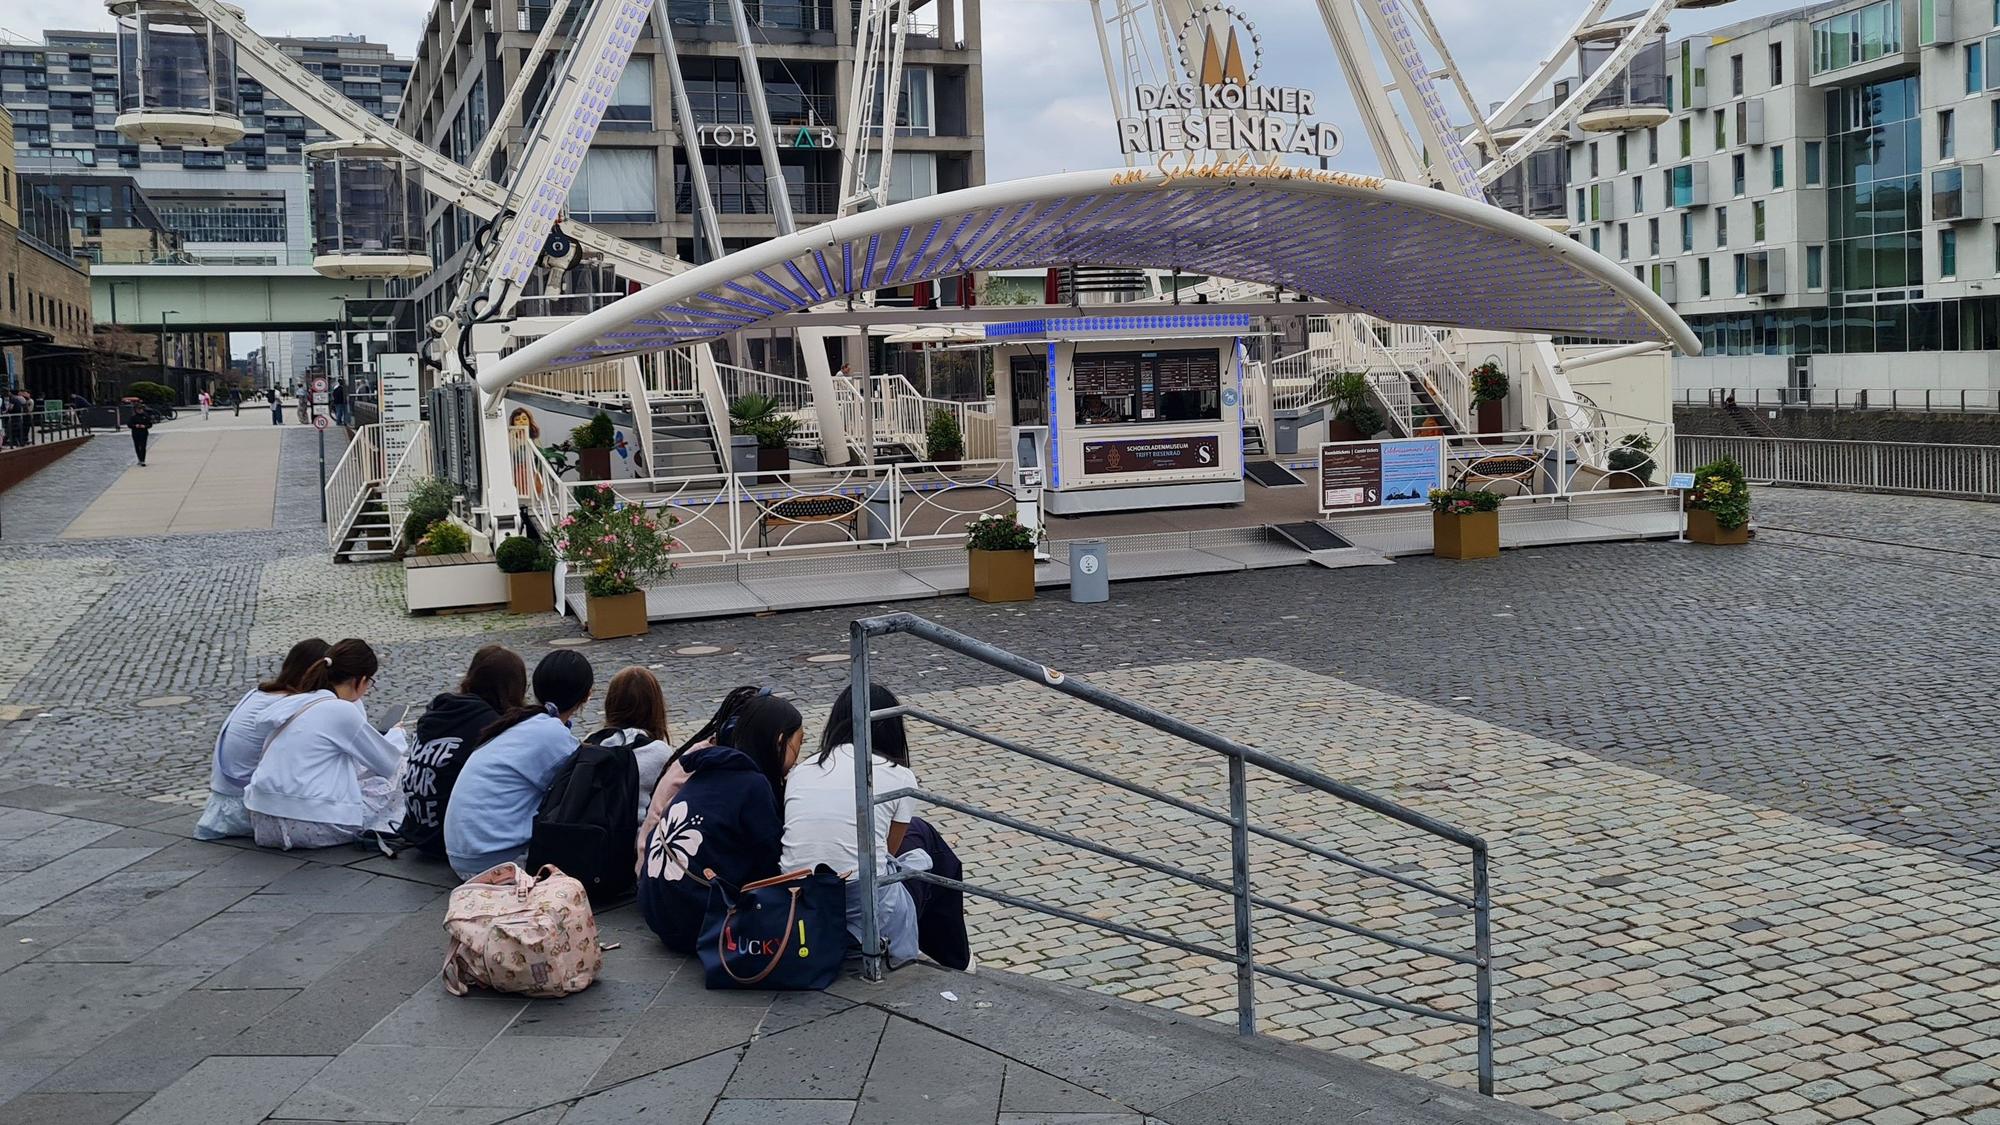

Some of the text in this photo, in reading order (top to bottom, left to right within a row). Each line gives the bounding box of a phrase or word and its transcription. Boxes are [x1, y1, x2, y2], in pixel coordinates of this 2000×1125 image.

[1136, 77, 1315, 115] DAS KÖLNER
[1118, 115, 1344, 157] RIESENRAD
[1110, 151, 1385, 190] am Schokoladenmuseum
[1126, 443, 1189, 452] SCHOKOLADENMUSEUM
[1152, 450, 1181, 458] RIESENRAD
[1199, 445, 1211, 464] S
[1368, 489, 1376, 503] S
